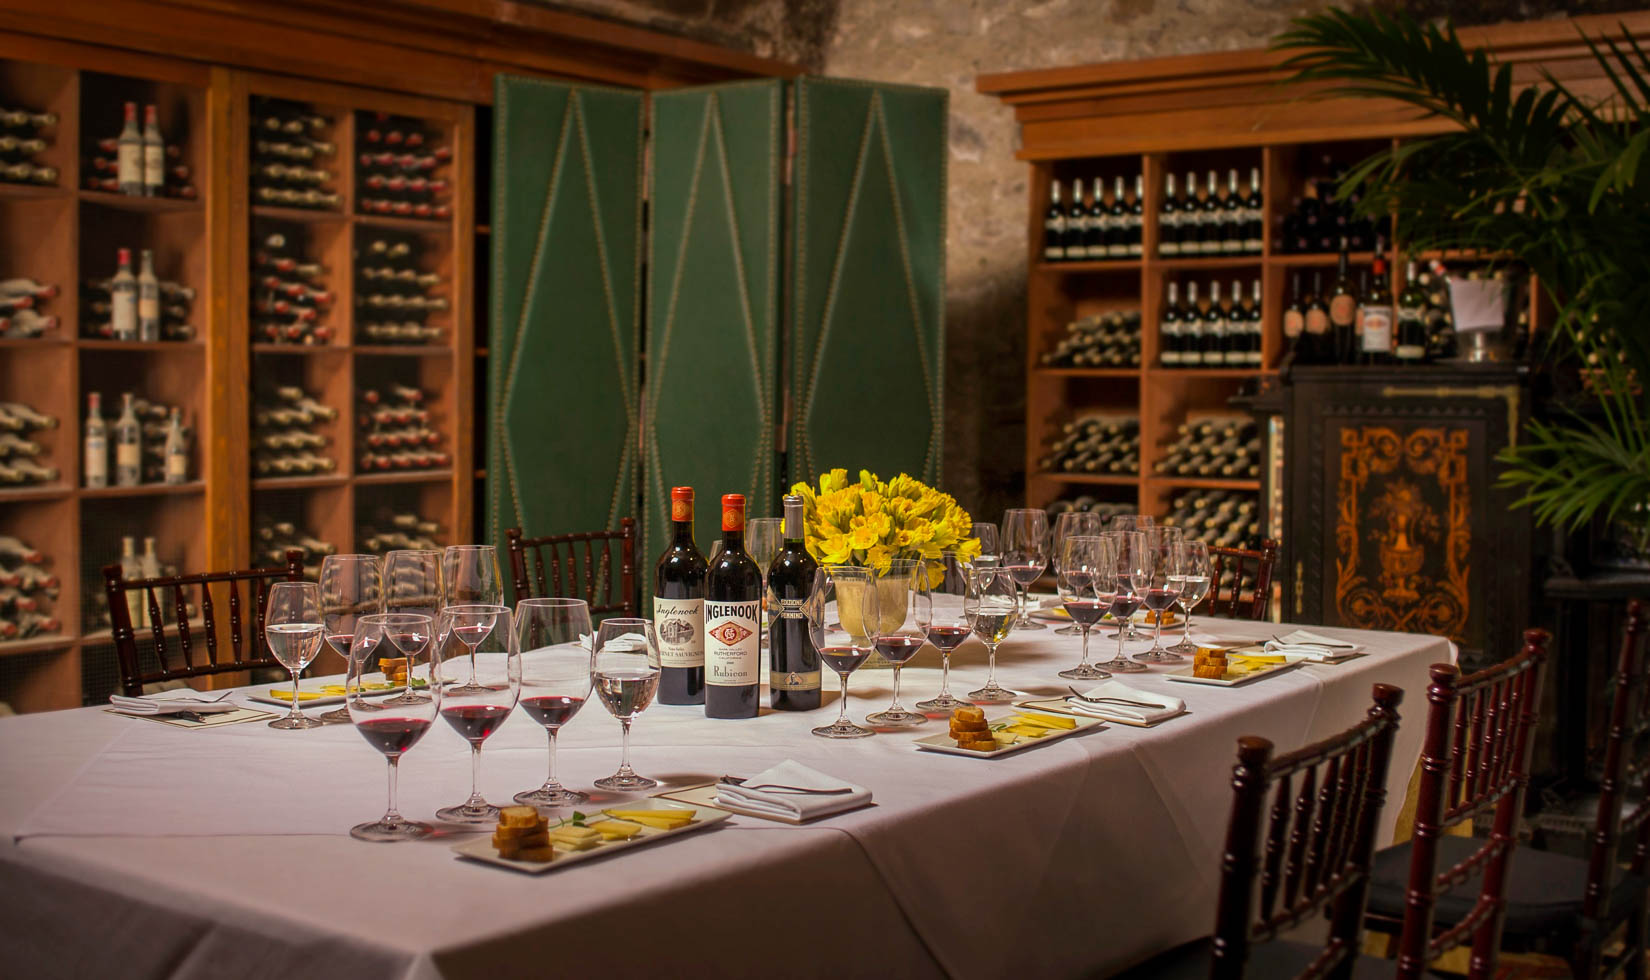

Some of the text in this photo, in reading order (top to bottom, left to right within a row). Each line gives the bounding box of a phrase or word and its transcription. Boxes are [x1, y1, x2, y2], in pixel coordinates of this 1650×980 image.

[656, 603, 700, 619] Inglenook
[705, 604, 758, 625] INGLENOOK
[713, 665, 748, 678] Rubicon
